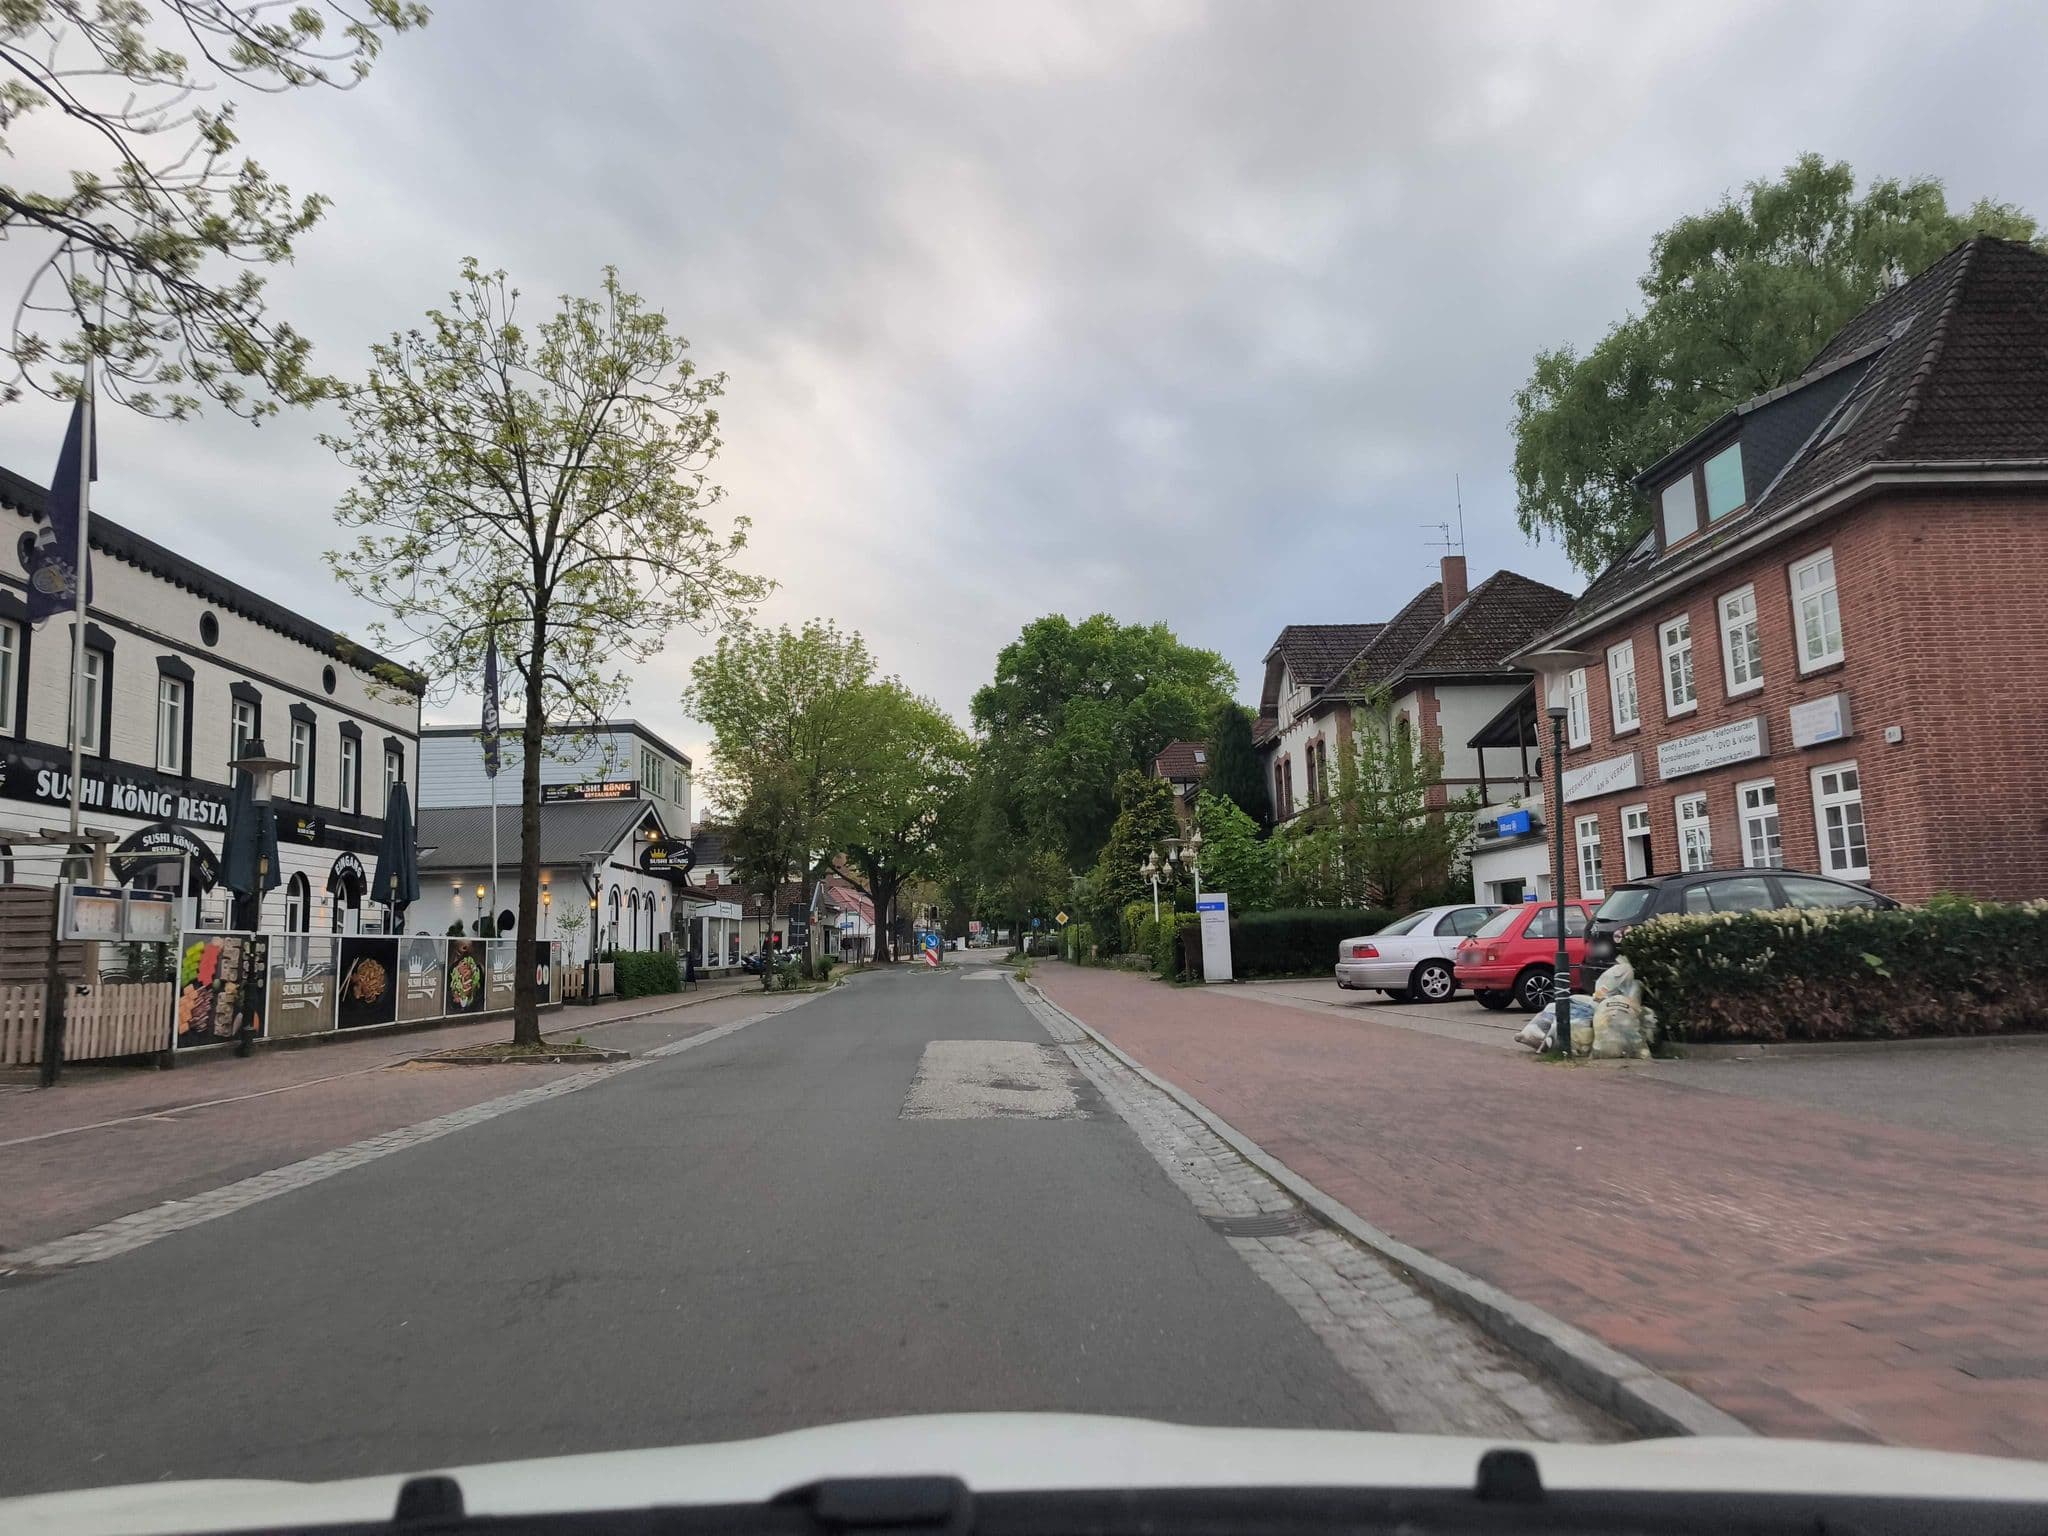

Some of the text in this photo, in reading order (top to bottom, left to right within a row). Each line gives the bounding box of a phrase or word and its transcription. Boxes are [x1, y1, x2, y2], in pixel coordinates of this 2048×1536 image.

[603, 783, 631, 792] KÖNIG
[111, 783, 172, 817] KÖNIG
[142, 832, 200, 857] SUSHI KÖNIG
[334, 855, 362, 878] EINGANG
